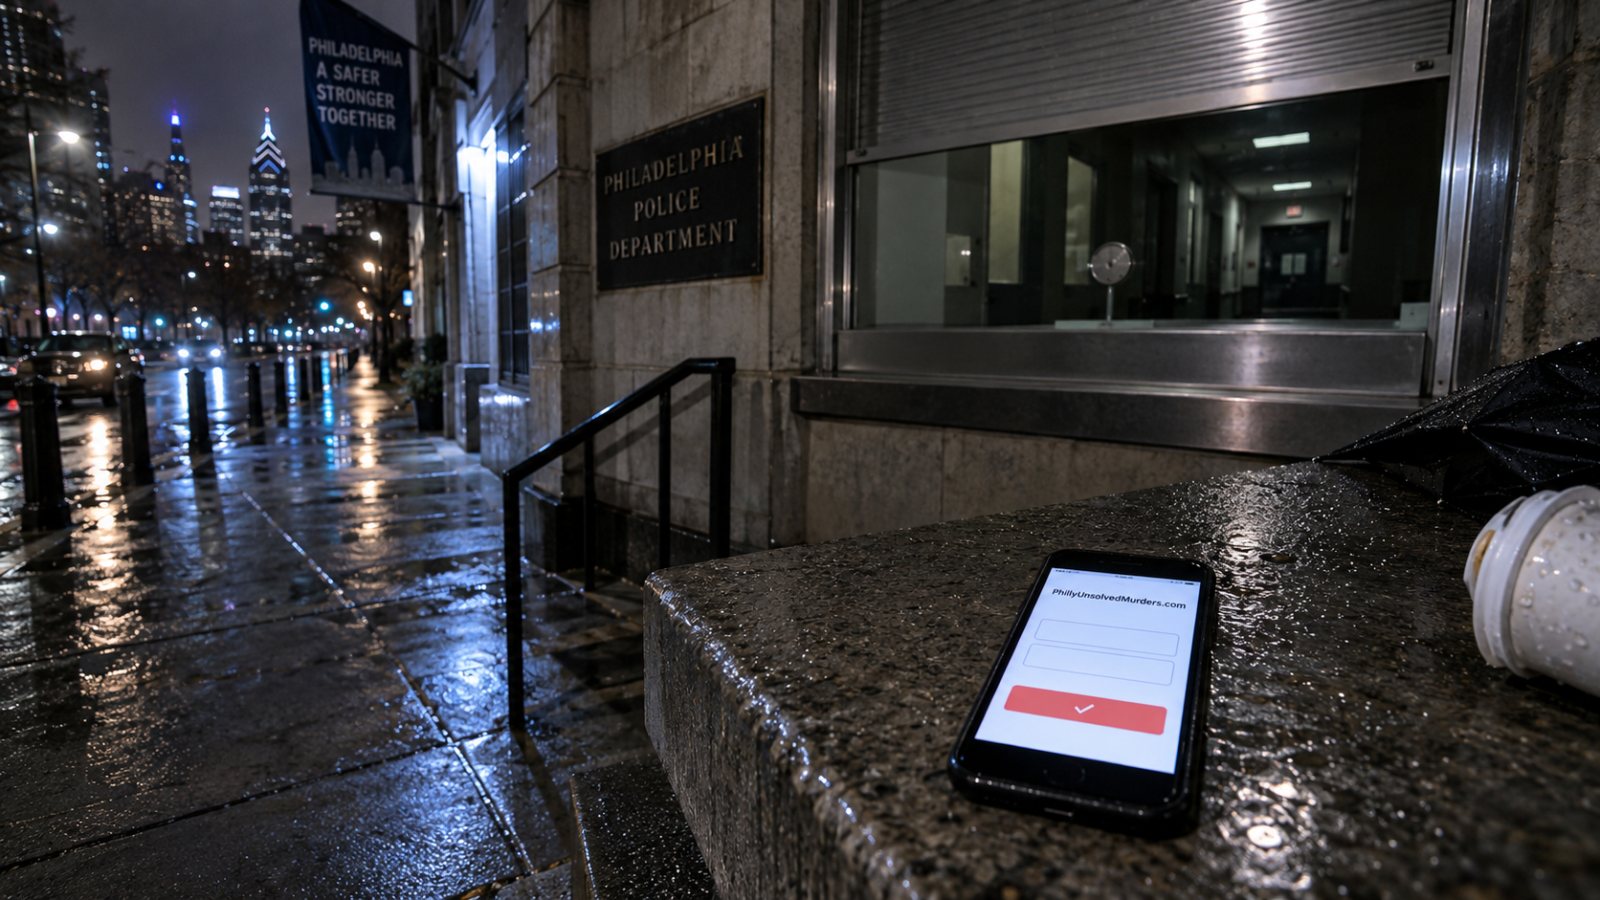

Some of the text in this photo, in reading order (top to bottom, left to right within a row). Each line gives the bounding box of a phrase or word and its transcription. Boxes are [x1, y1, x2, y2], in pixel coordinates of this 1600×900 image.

[308, 37, 403, 67] PHILADELPHIA
[316, 61, 380, 86] A SAFER
[316, 83, 395, 109] STRONGER
[317, 105, 396, 130] TOGETHER
[603, 135, 743, 195] PHILADELPHIA
[634, 187, 700, 222] POLICE
[610, 219, 738, 260] DEPARTMENT
[1052, 588, 1187, 610] PhillyUnsolvedMurders.com
